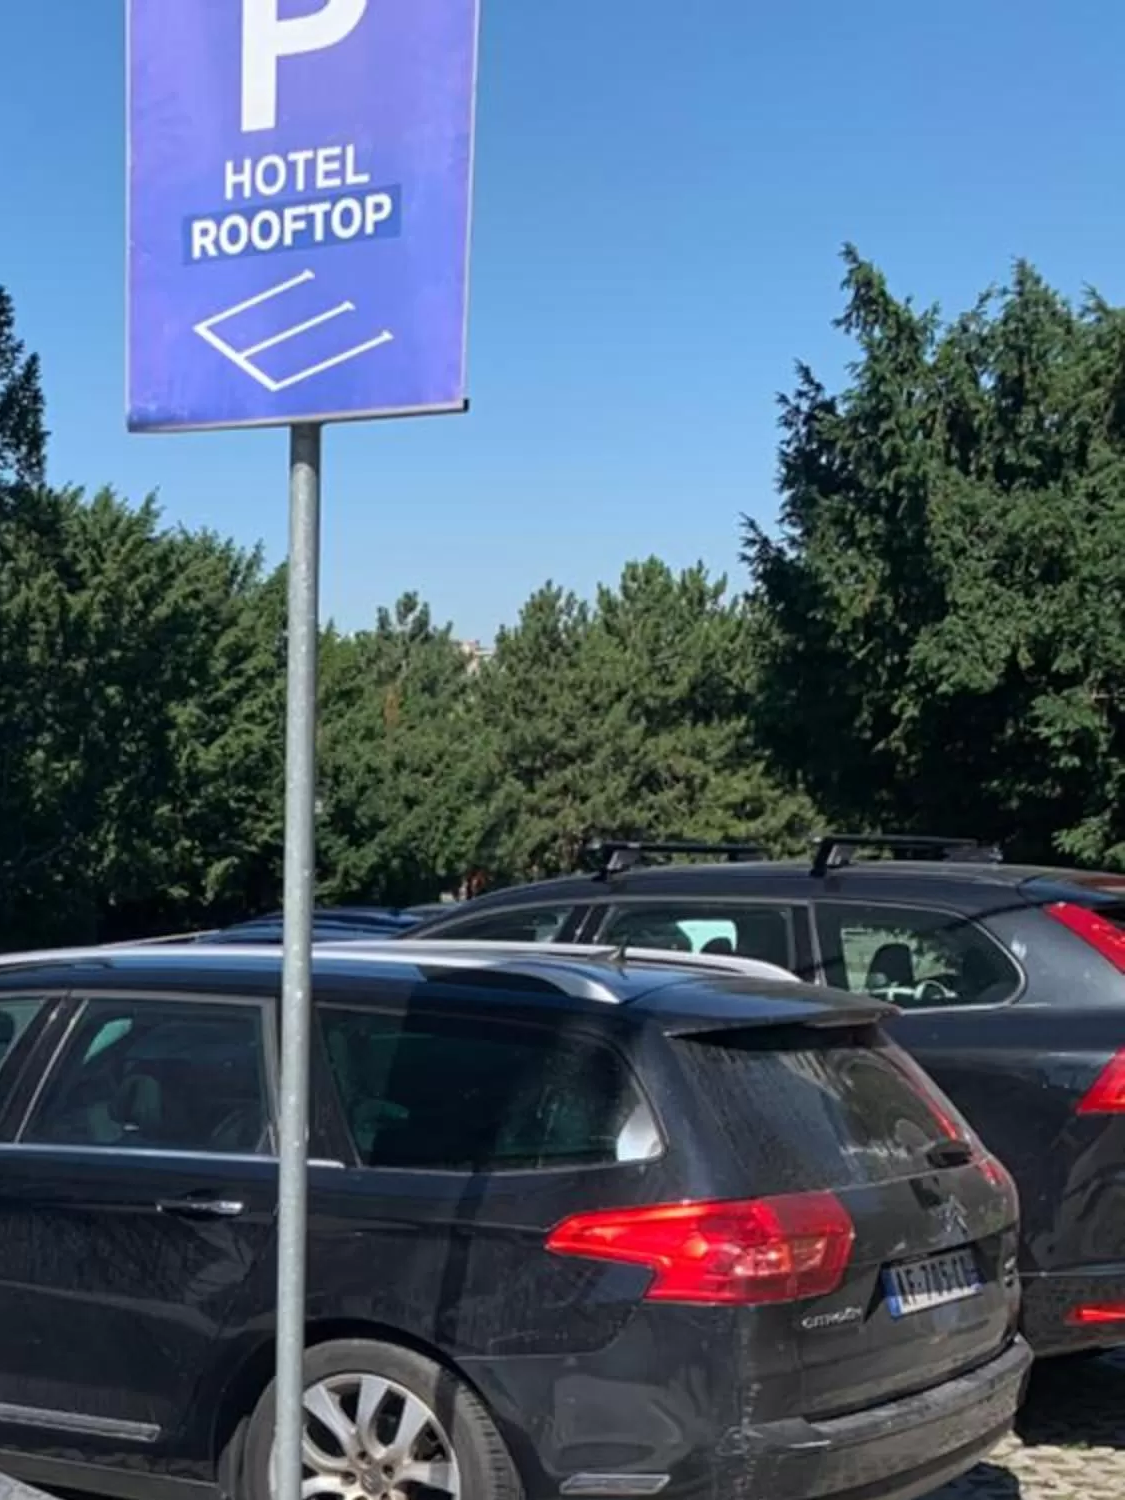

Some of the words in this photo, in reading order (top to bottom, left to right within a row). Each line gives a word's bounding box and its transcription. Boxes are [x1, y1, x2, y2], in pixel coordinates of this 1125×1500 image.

[241, 0, 368, 132] P
[224, 144, 370, 200] HOTEL
[191, 193, 393, 260] ROOFTOP
